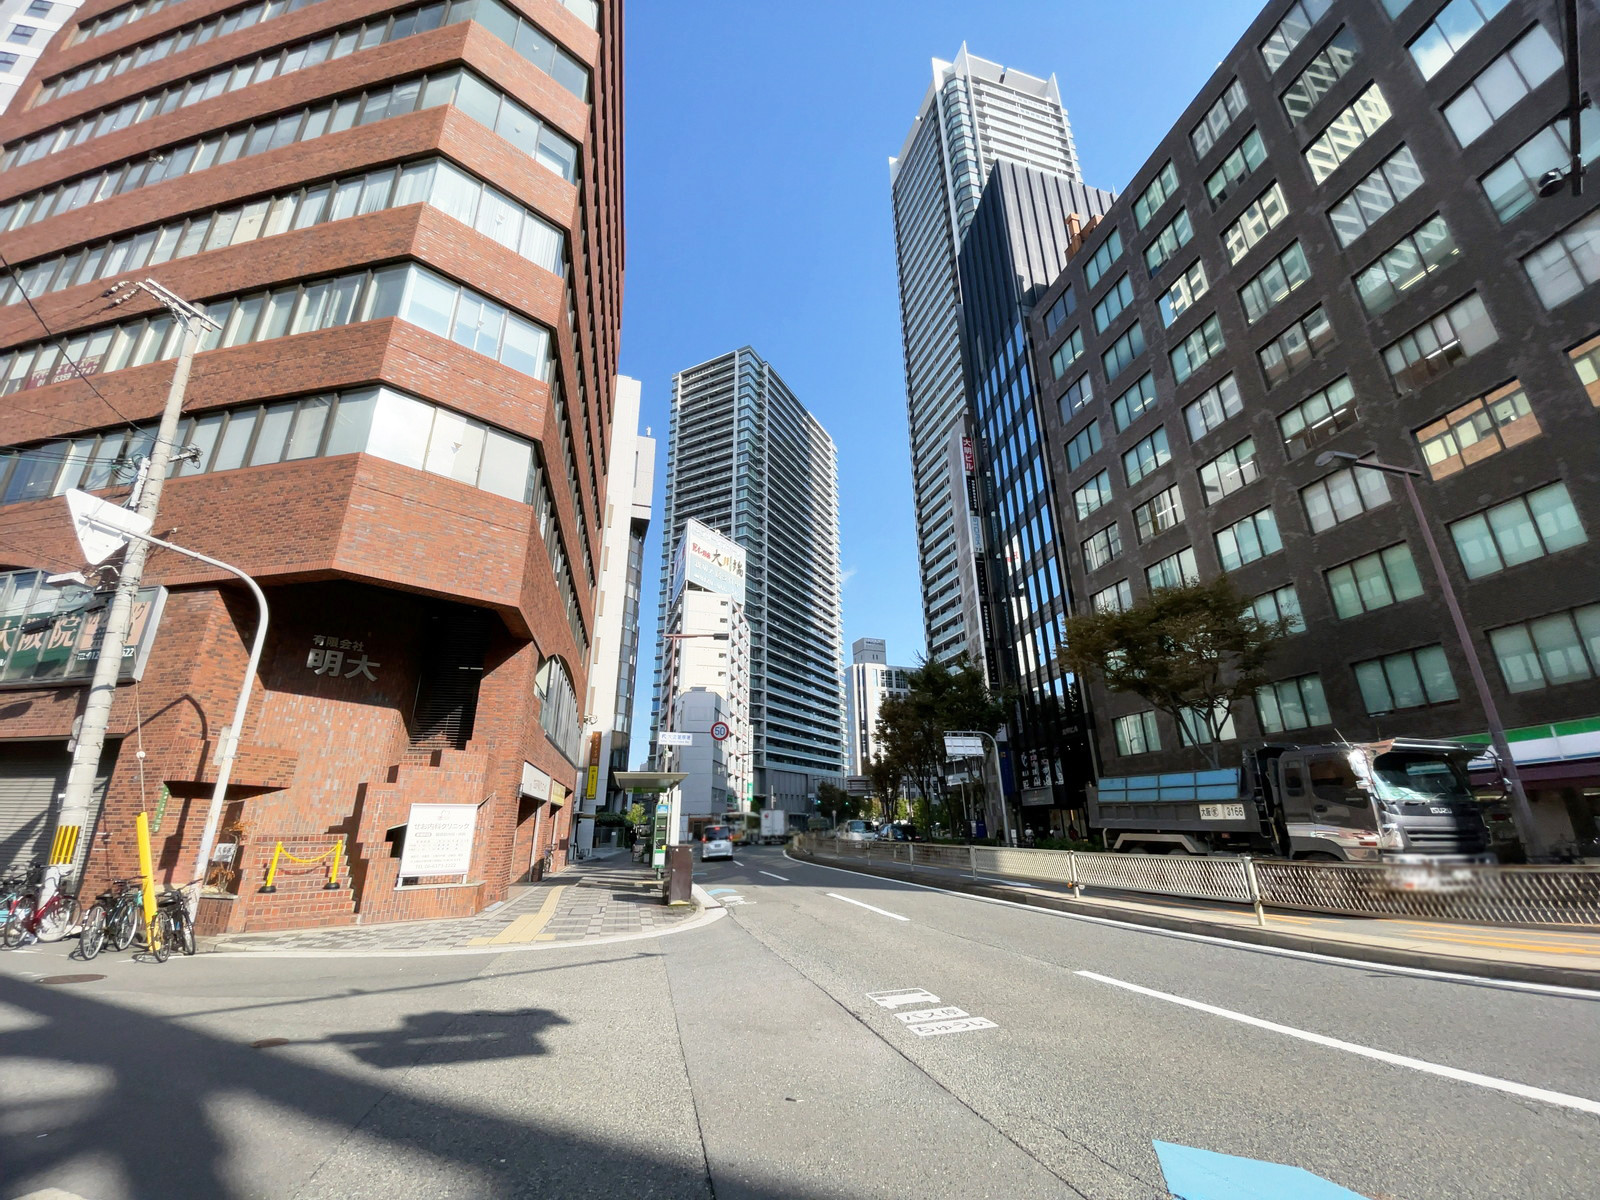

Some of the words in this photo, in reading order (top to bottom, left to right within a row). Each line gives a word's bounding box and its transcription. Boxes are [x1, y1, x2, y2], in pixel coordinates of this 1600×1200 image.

[963, 438, 974, 471] 大明ビル
[313, 634, 364, 652] 有限会社
[306, 648, 381, 682] 明大
[714, 726, 726, 736] 50
[906, 1009, 959, 1020] バス停
[917, 1020, 991, 1033] ちゅうい
